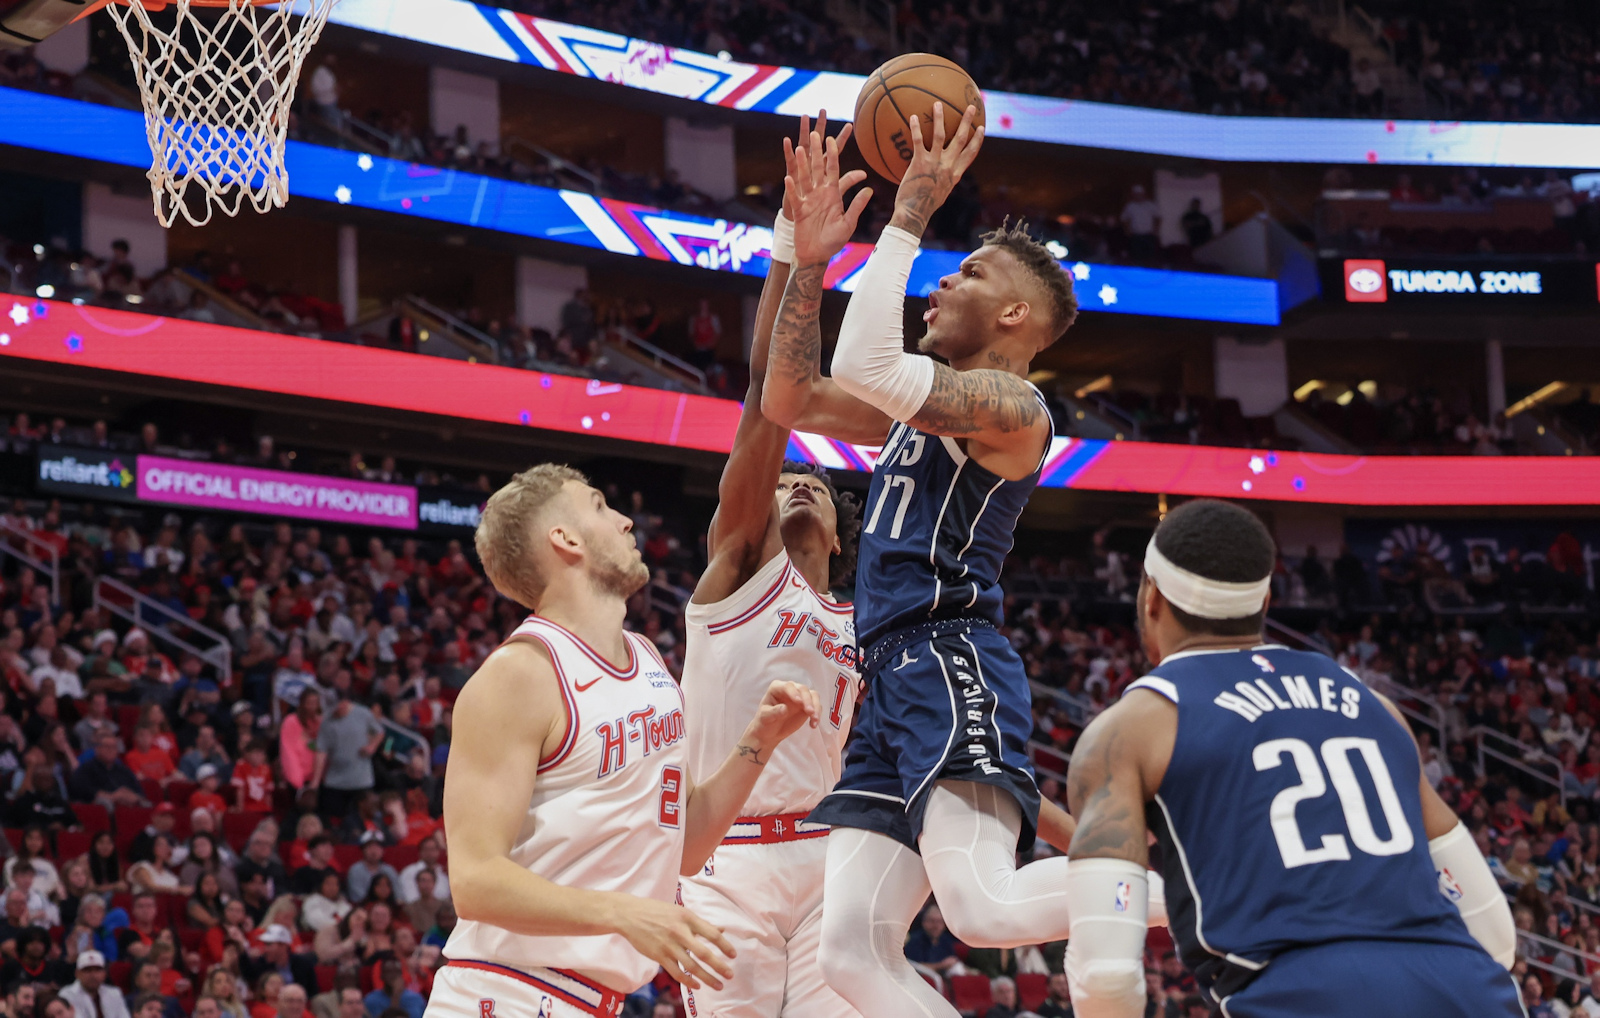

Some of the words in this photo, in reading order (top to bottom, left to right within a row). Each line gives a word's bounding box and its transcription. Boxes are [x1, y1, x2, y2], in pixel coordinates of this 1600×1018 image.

[1388, 269, 1477, 293] TUNDRA
[1480, 271, 1542, 294] ZONE
[40, 456, 111, 486] reliant
[145, 467, 237, 499] OFFICIAL
[239, 478, 316, 508] ENERGY
[316, 488, 410, 518] PROVIDER
[419, 499, 482, 527] reliant
[829, 671, 850, 730] 1
[1213, 675, 1360, 723] HOLMES
[658, 765, 682, 829] 2
[1252, 736, 1414, 869] 20
